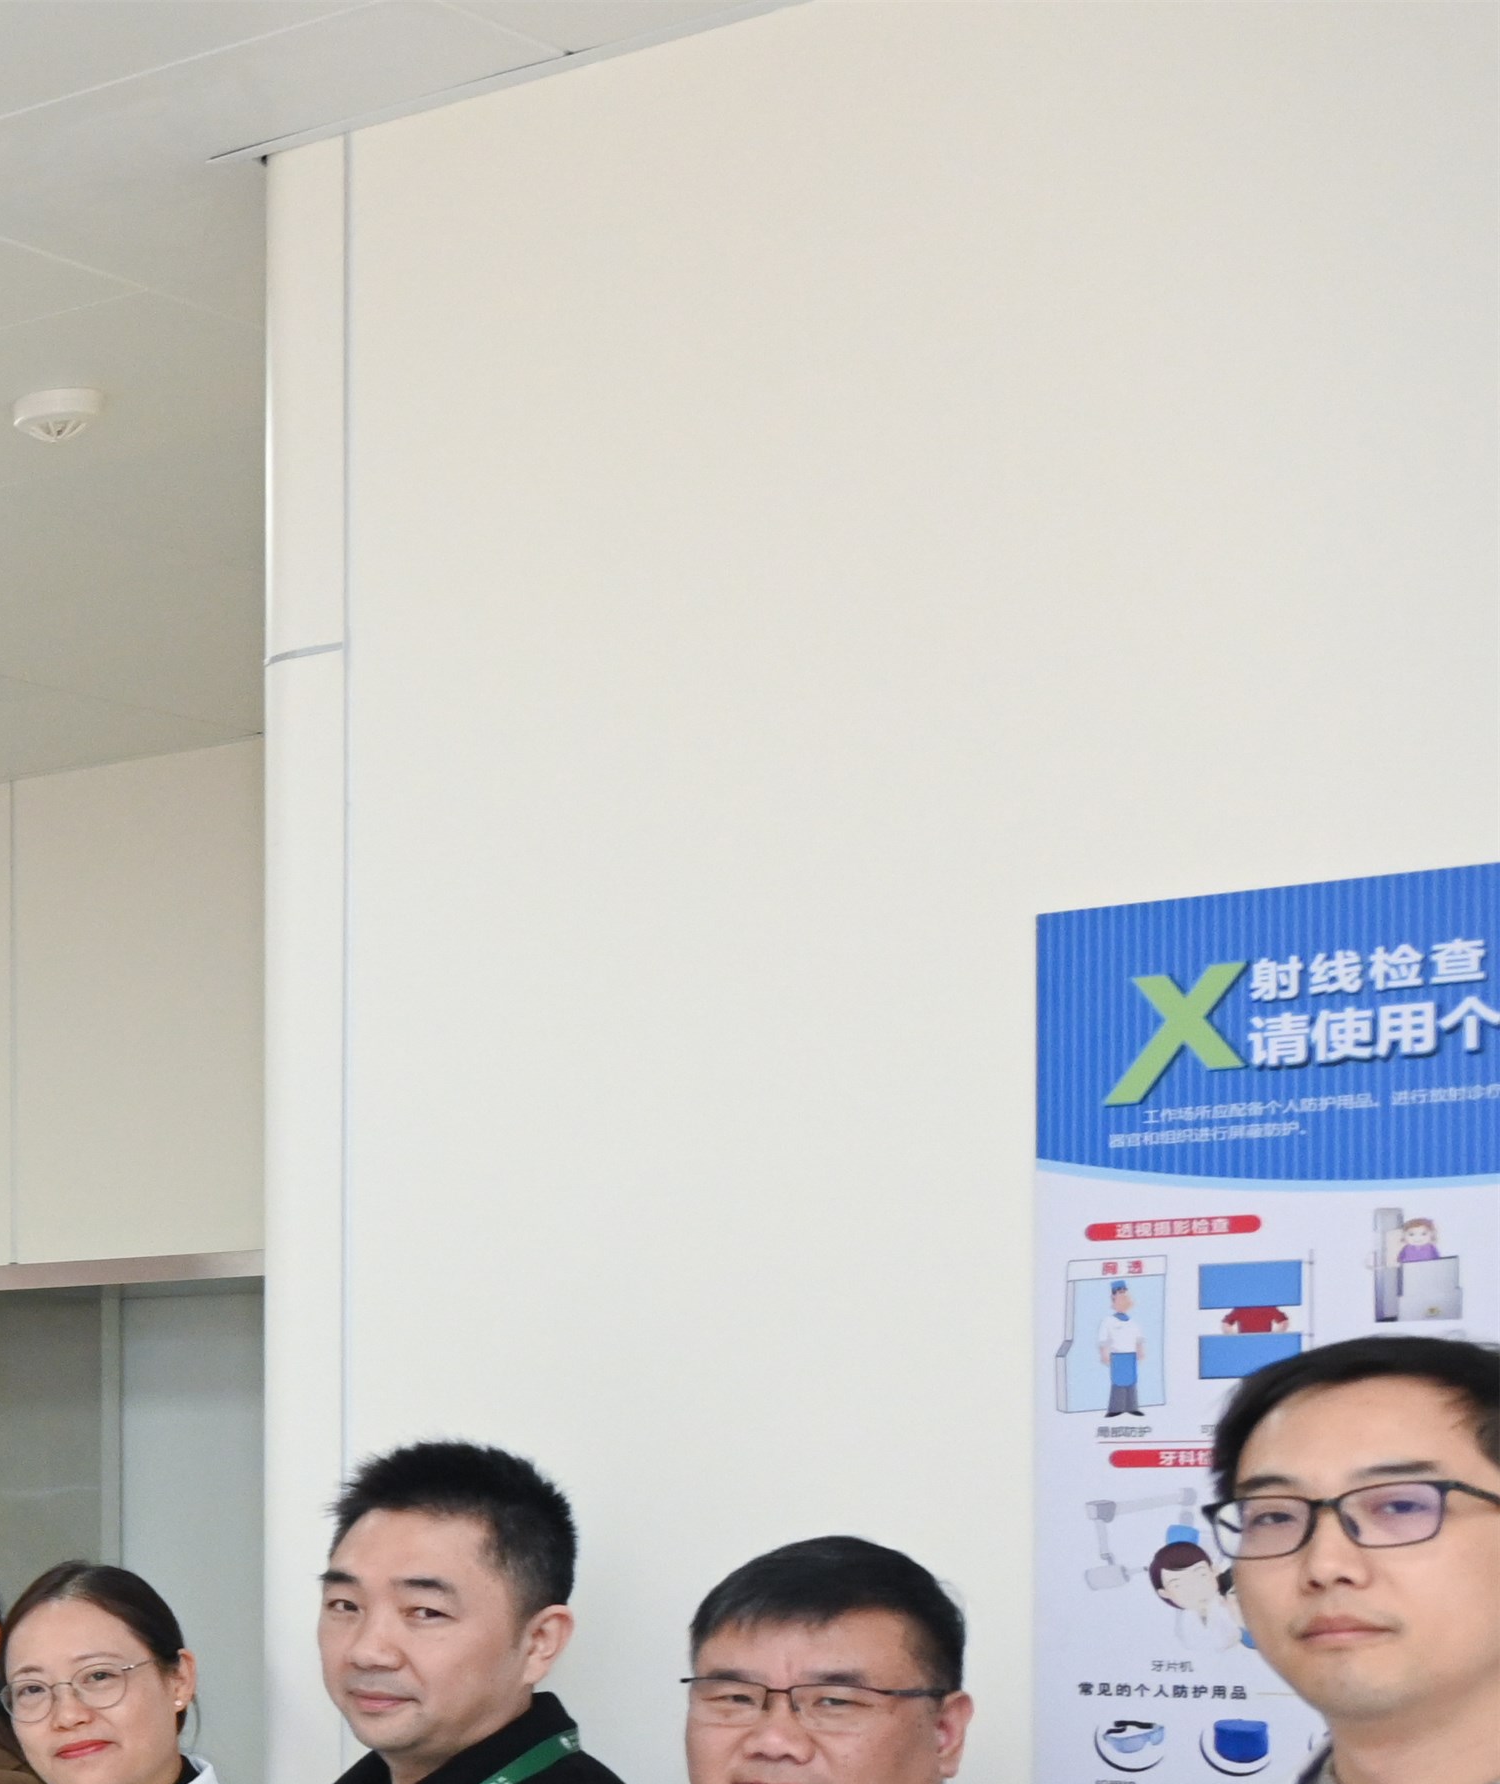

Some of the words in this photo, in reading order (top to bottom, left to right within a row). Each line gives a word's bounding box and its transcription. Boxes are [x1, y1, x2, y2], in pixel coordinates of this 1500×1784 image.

[1249, 938, 1486, 1002] 射线检查
[1248, 996, 1500, 1067] 请使用个
[1159, 1451, 1213, 1466] 牙科检
[1151, 1659, 1194, 1673] 牙片机
[1077, 1681, 1248, 1700] 常见的个人防护用品
